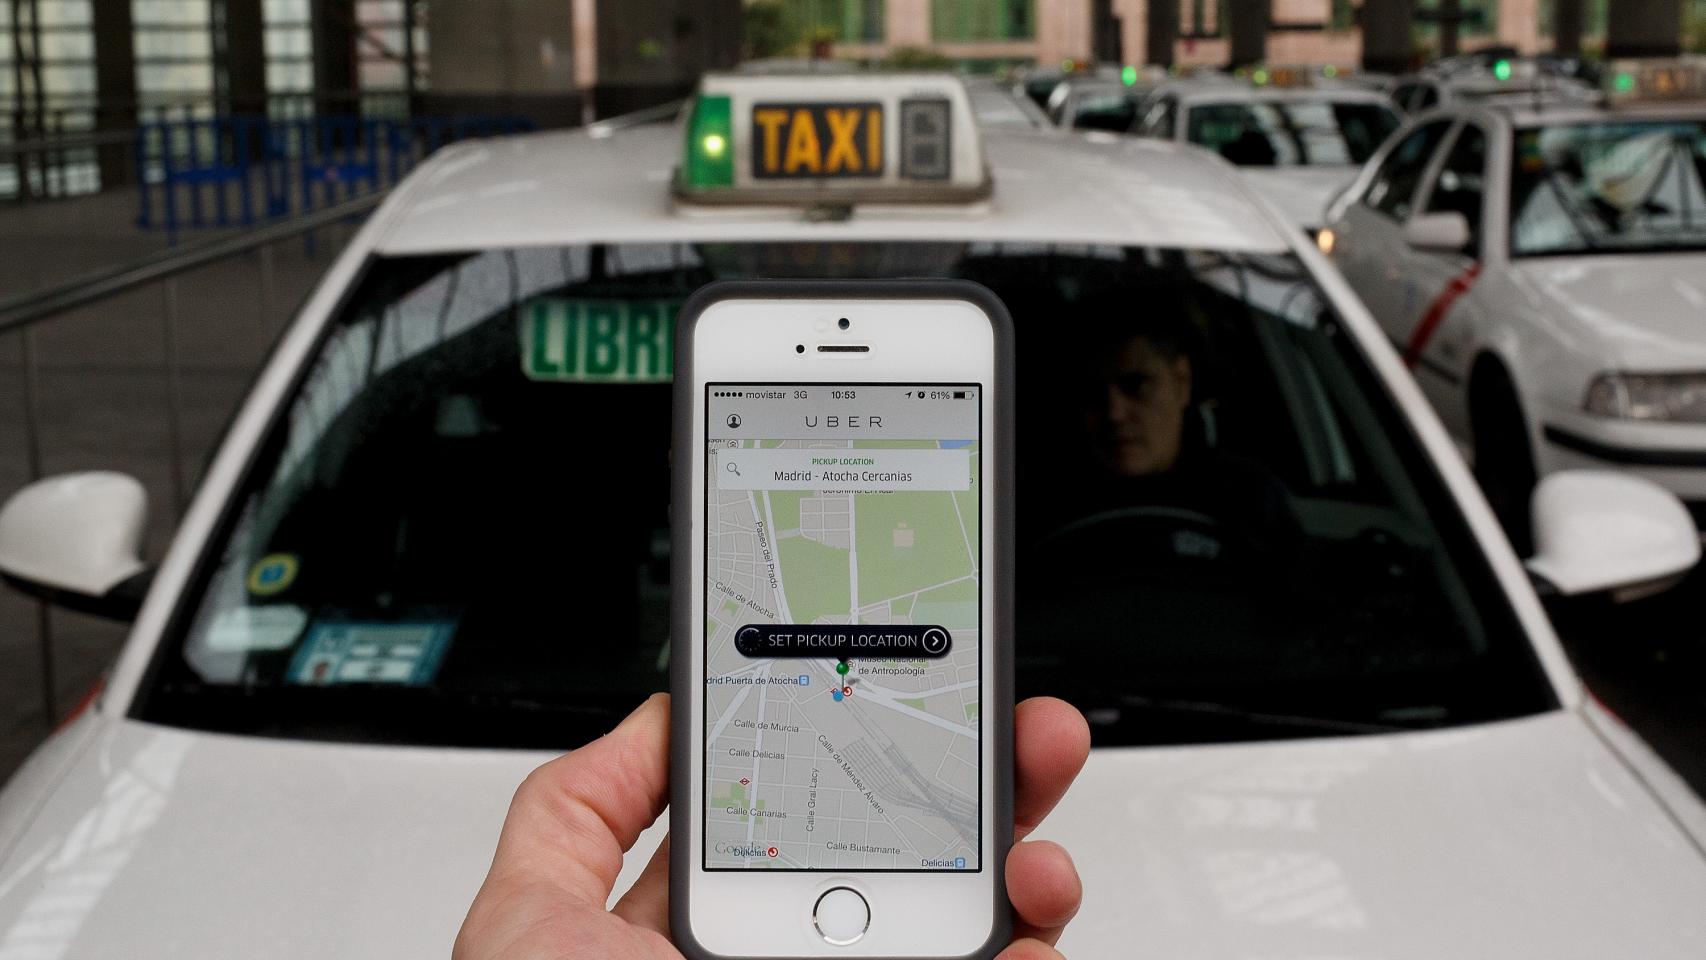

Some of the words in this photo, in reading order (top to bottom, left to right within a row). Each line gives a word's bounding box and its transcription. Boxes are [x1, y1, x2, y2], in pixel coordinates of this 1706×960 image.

[754, 109, 882, 173] TAXI
[746, 391, 786, 399] movistar
[794, 391, 808, 399] 3G
[831, 391, 856, 399] 10:53
[930, 391, 950, 399] 61%
[806, 416, 882, 428] UBER
[774, 471, 811, 481] Madrid
[822, 471, 858, 481] Atocha
[756, 521, 766, 548] Paseo
[763, 549, 772, 562] del
[767, 564, 778, 588] Prado
[716, 582, 734, 596] Calle
[736, 594, 746, 604] de
[747, 600, 774, 618] Atocha
[768, 634, 792, 646] SET
[797, 634, 846, 646] PICKUP
[851, 634, 918, 647] LOCATION
[871, 666, 925, 676] Antropología
[768, 677, 798, 685] Atocha
[734, 720, 755, 728] Calle
[771, 723, 799, 732] Murcia
[729, 748, 750, 757] Calle
[752, 750, 785, 760] Delicias
[819, 735, 834, 753] Calle
[833, 754, 842, 763] de
[810, 768, 820, 788] Lacy
[808, 790, 816, 808] Gral
[726, 807, 747, 816] Calle
[750, 808, 787, 819] Canarias
[806, 810, 814, 832] Calle
[826, 842, 848, 851] Calle
[850, 843, 900, 855] Bustamante
[922, 859, 954, 867] Delicias
